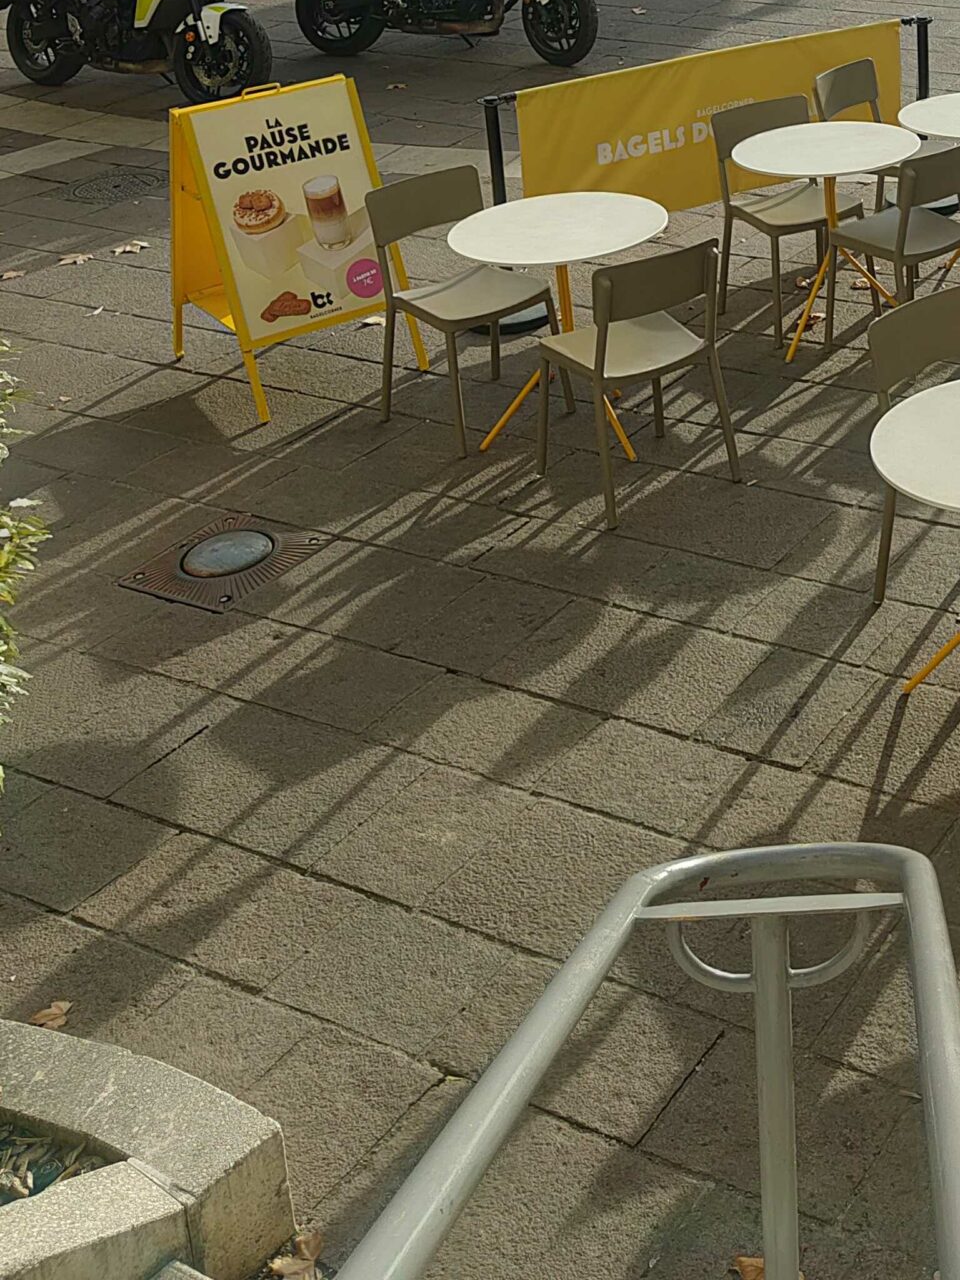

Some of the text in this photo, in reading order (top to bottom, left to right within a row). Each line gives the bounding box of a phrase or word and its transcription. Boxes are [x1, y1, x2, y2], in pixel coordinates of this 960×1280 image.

[244, 123, 312, 154] PAUSE
[265, 117, 284, 130] LA
[213, 133, 351, 180] GOURMANDE
[597, 125, 686, 166] BAGELS
